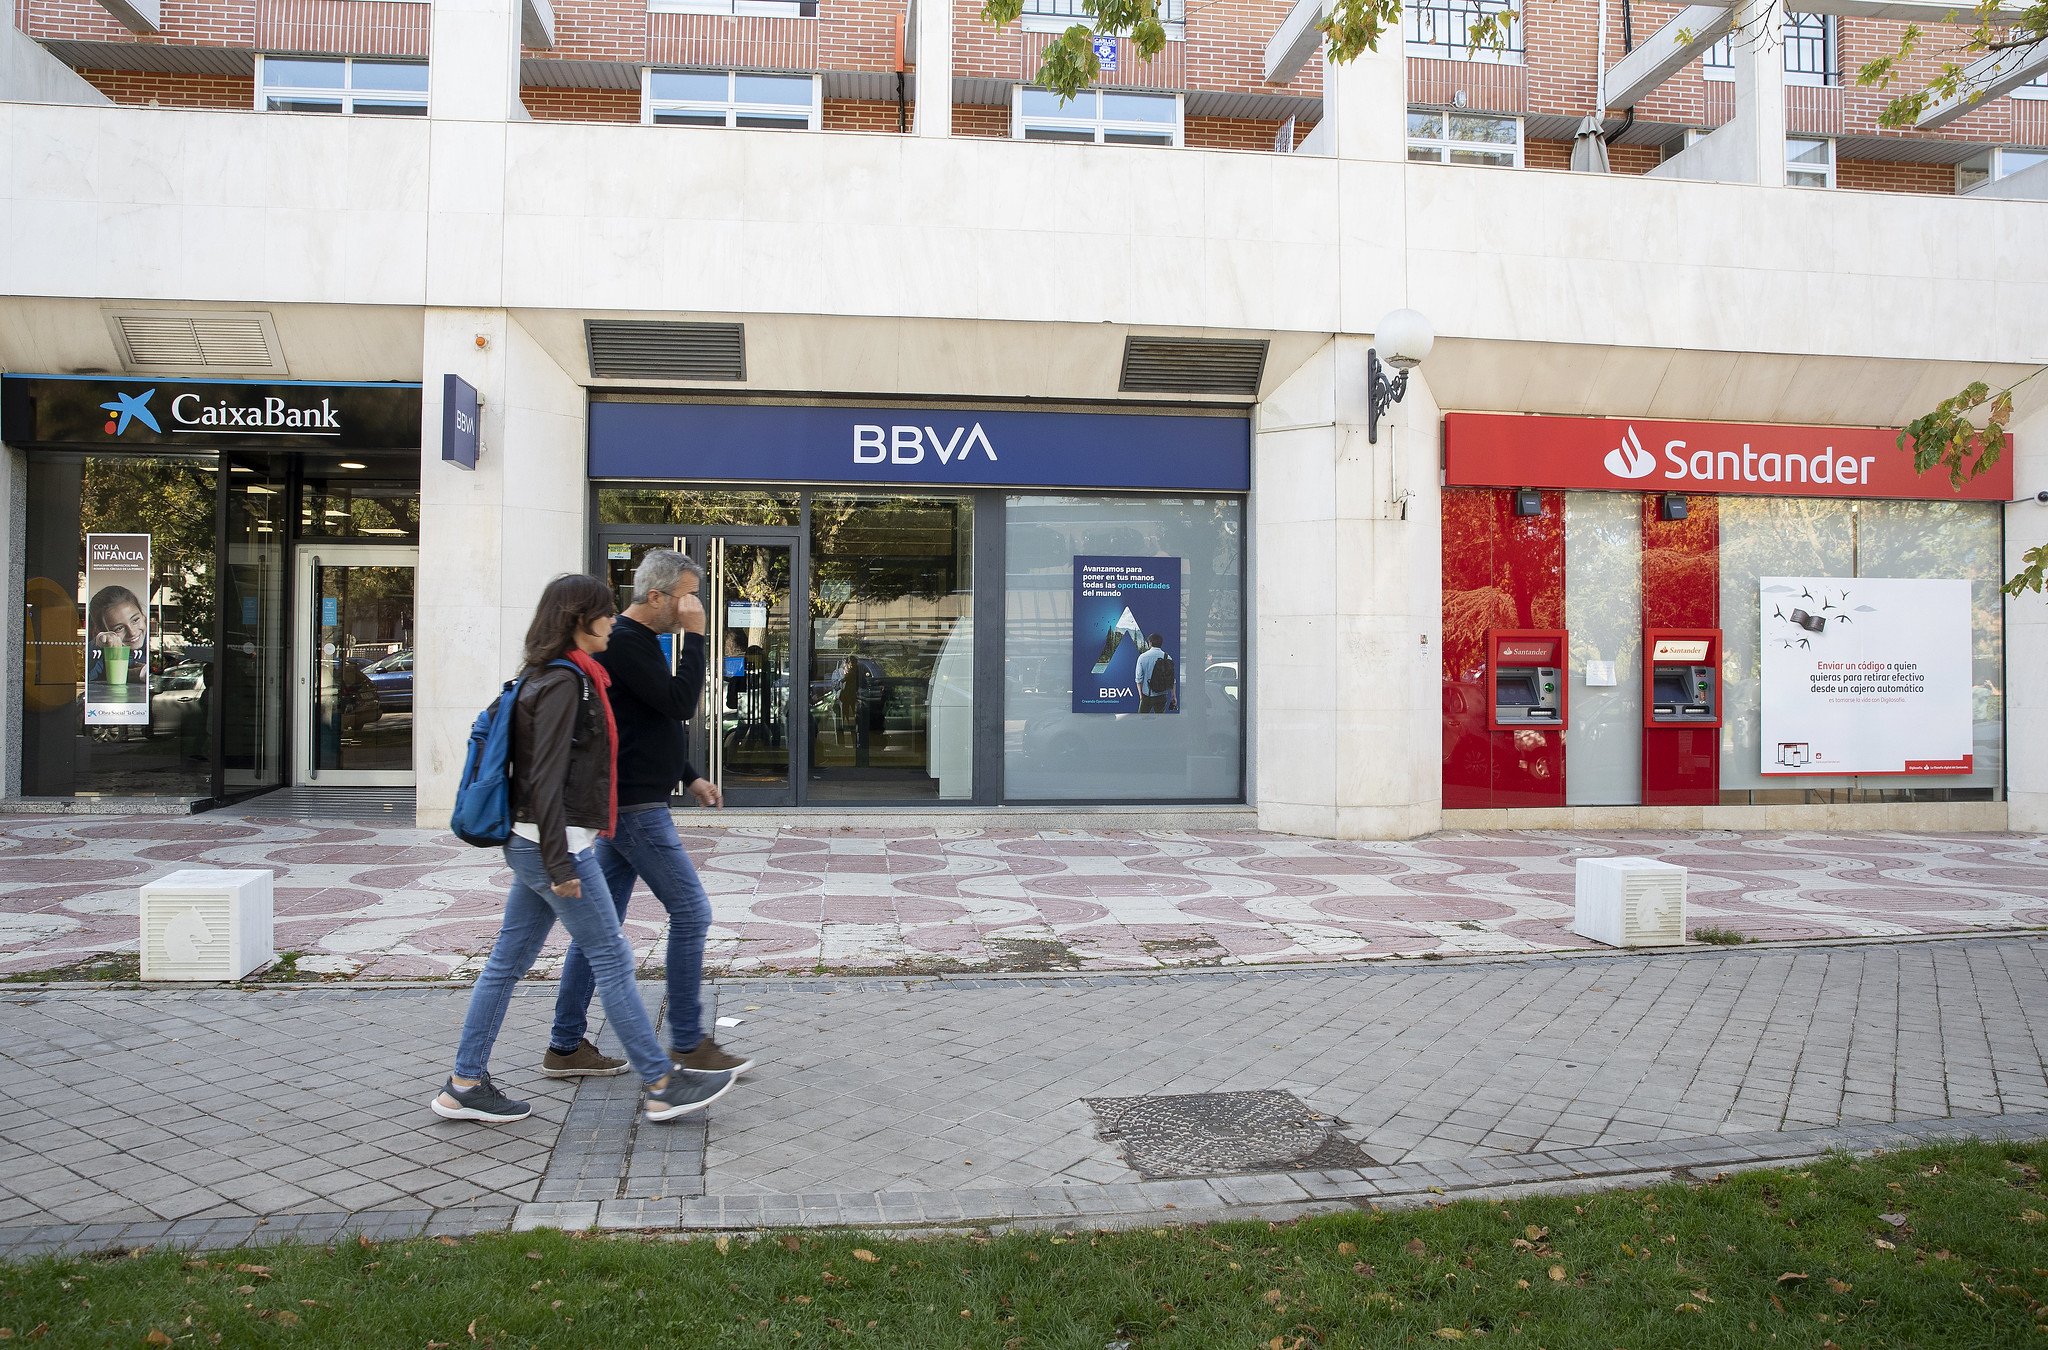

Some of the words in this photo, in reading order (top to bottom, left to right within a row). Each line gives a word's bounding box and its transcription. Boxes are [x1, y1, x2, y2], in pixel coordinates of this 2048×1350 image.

[171, 393, 341, 428] CaixaBank
[456, 409, 475, 436] BBVA
[853, 421, 998, 466] BBVA
[1664, 439, 1876, 485] Santander
[93, 543, 109, 551] CON
[110, 543, 120, 551] LA
[93, 551, 144, 560] INFANCIA
[1082, 565, 1124, 573] Avanzamos
[1125, 566, 1142, 574] para
[1082, 581, 1104, 589] todas
[1105, 581, 1116, 589] las
[1117, 582, 1170, 590] oportunidades
[1082, 589, 1094, 597] del
[1095, 589, 1122, 597] mundo
[1513, 648, 1547, 656] Santander
[1669, 646, 1701, 654] Santander
[1817, 661, 1844, 670] Enviar
[1857, 661, 1885, 672] código
[1893, 661, 1917, 672] quien
[1809, 672, 1841, 683] quieras
[1843, 674, 1862, 683] para
[1863, 672, 1890, 682] retirar
[1891, 672, 1925, 682] efectivo
[1099, 687, 1133, 698] BBVA
[1810, 684, 1836, 693] desde
[1850, 684, 1876, 695] cajero
[1876, 683, 1924, 693] automático
